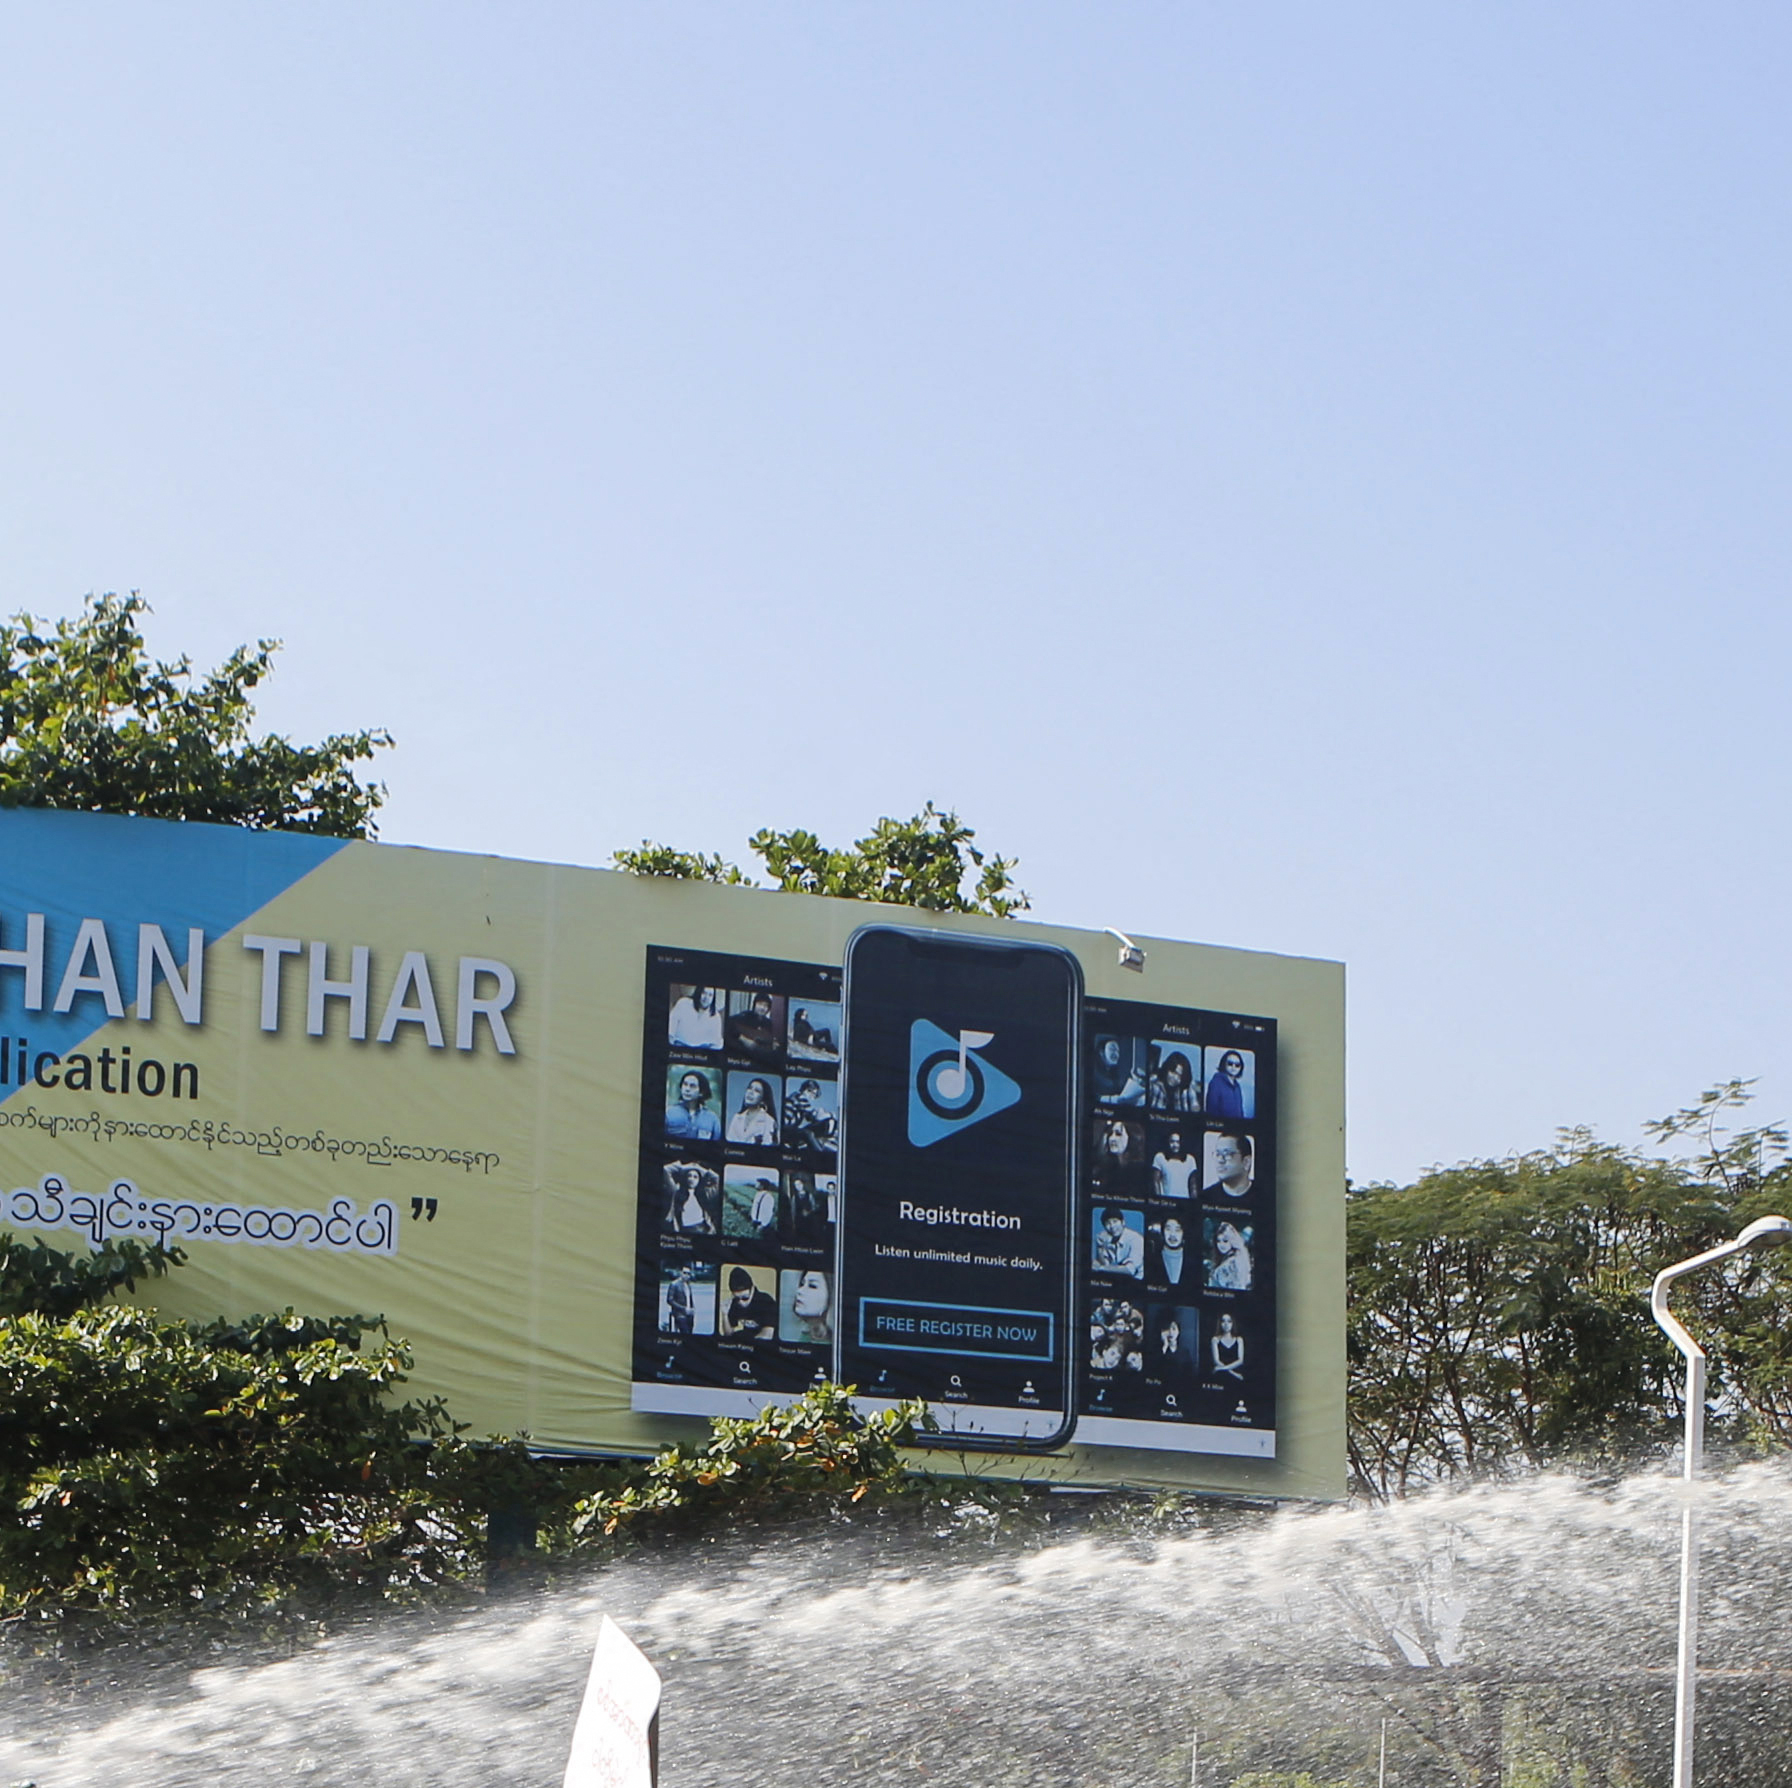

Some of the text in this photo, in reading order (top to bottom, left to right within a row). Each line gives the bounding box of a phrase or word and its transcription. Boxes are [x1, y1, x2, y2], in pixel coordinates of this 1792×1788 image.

[243, 934, 517, 1055] THAR
[743, 975, 773, 988] Artists
[1162, 1023, 1190, 1036] Artists
[899, 1201, 1021, 1230] Registration
[875, 1244, 1043, 1272] Listen unlimited music daily.
[876, 1316, 1037, 1342] FREE REGISTER NOW
